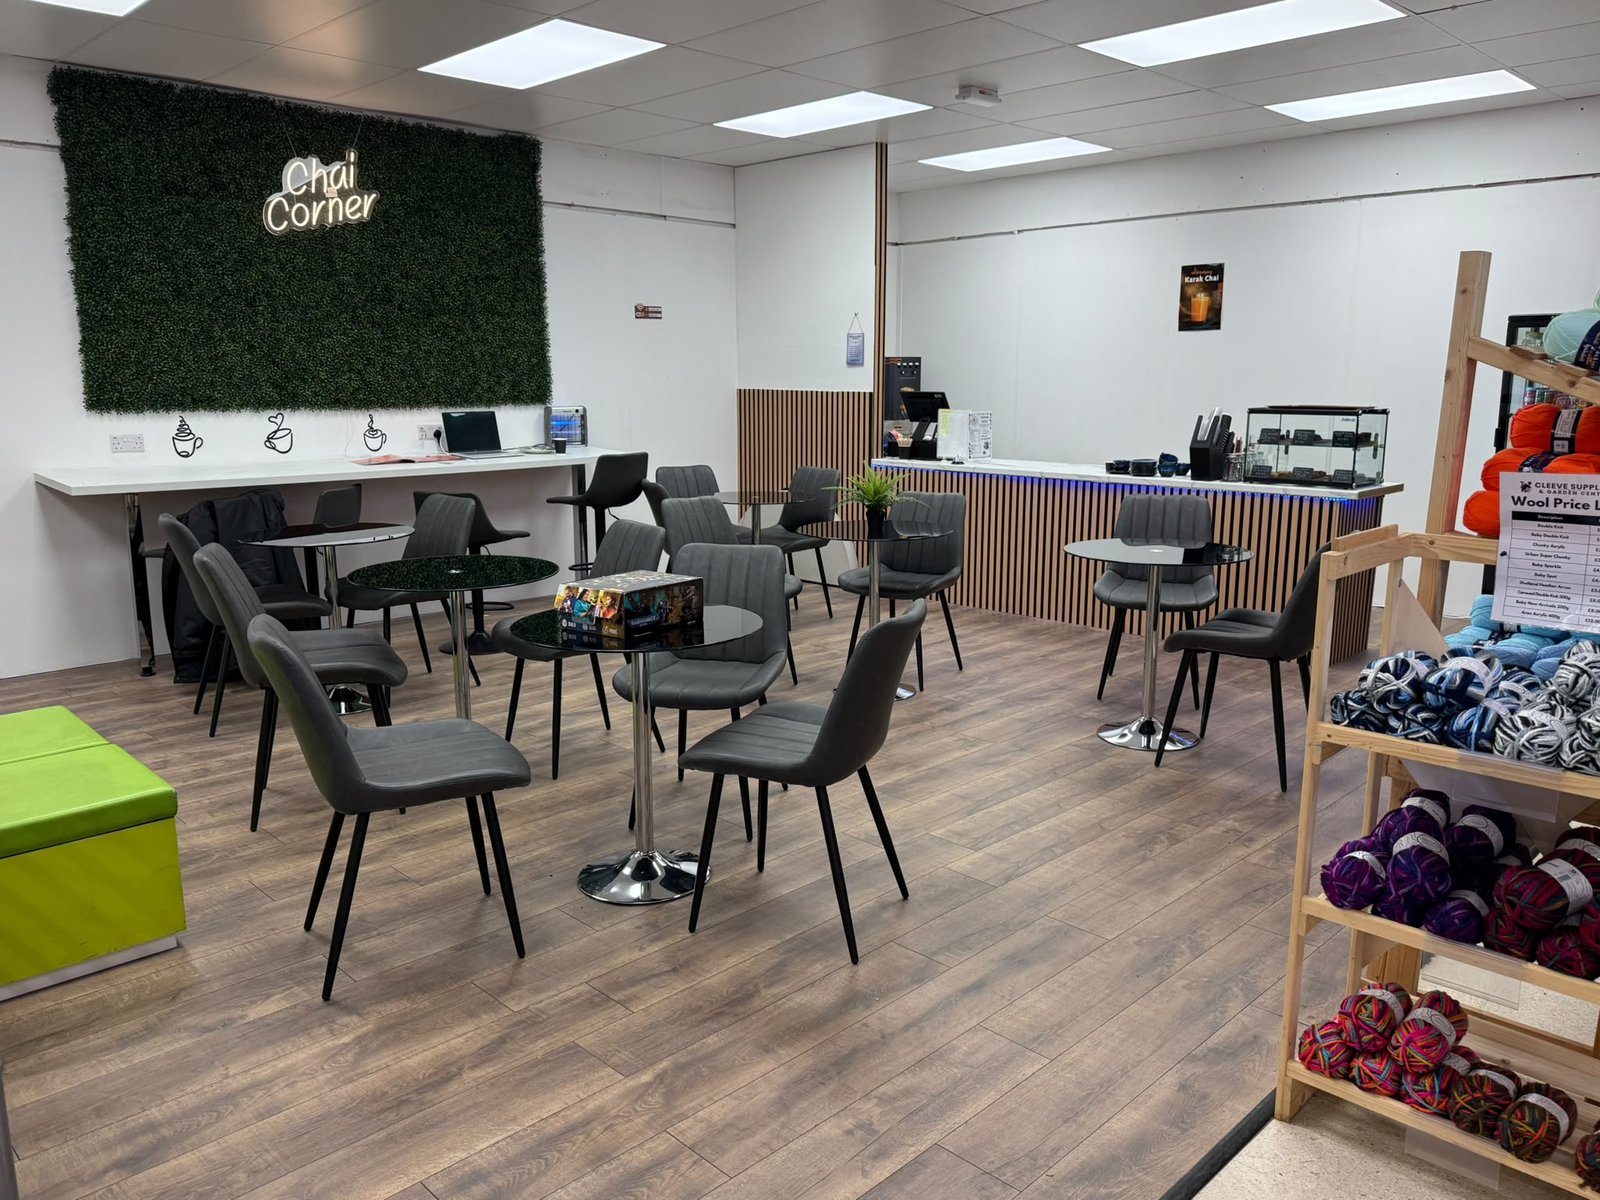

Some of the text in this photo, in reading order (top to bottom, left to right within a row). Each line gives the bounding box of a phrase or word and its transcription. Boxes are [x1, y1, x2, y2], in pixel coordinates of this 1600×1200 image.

[286, 151, 354, 196] Chai
[267, 193, 377, 231] Corner
[1511, 496, 1549, 508] Wool
[1554, 498, 1590, 510] Price
